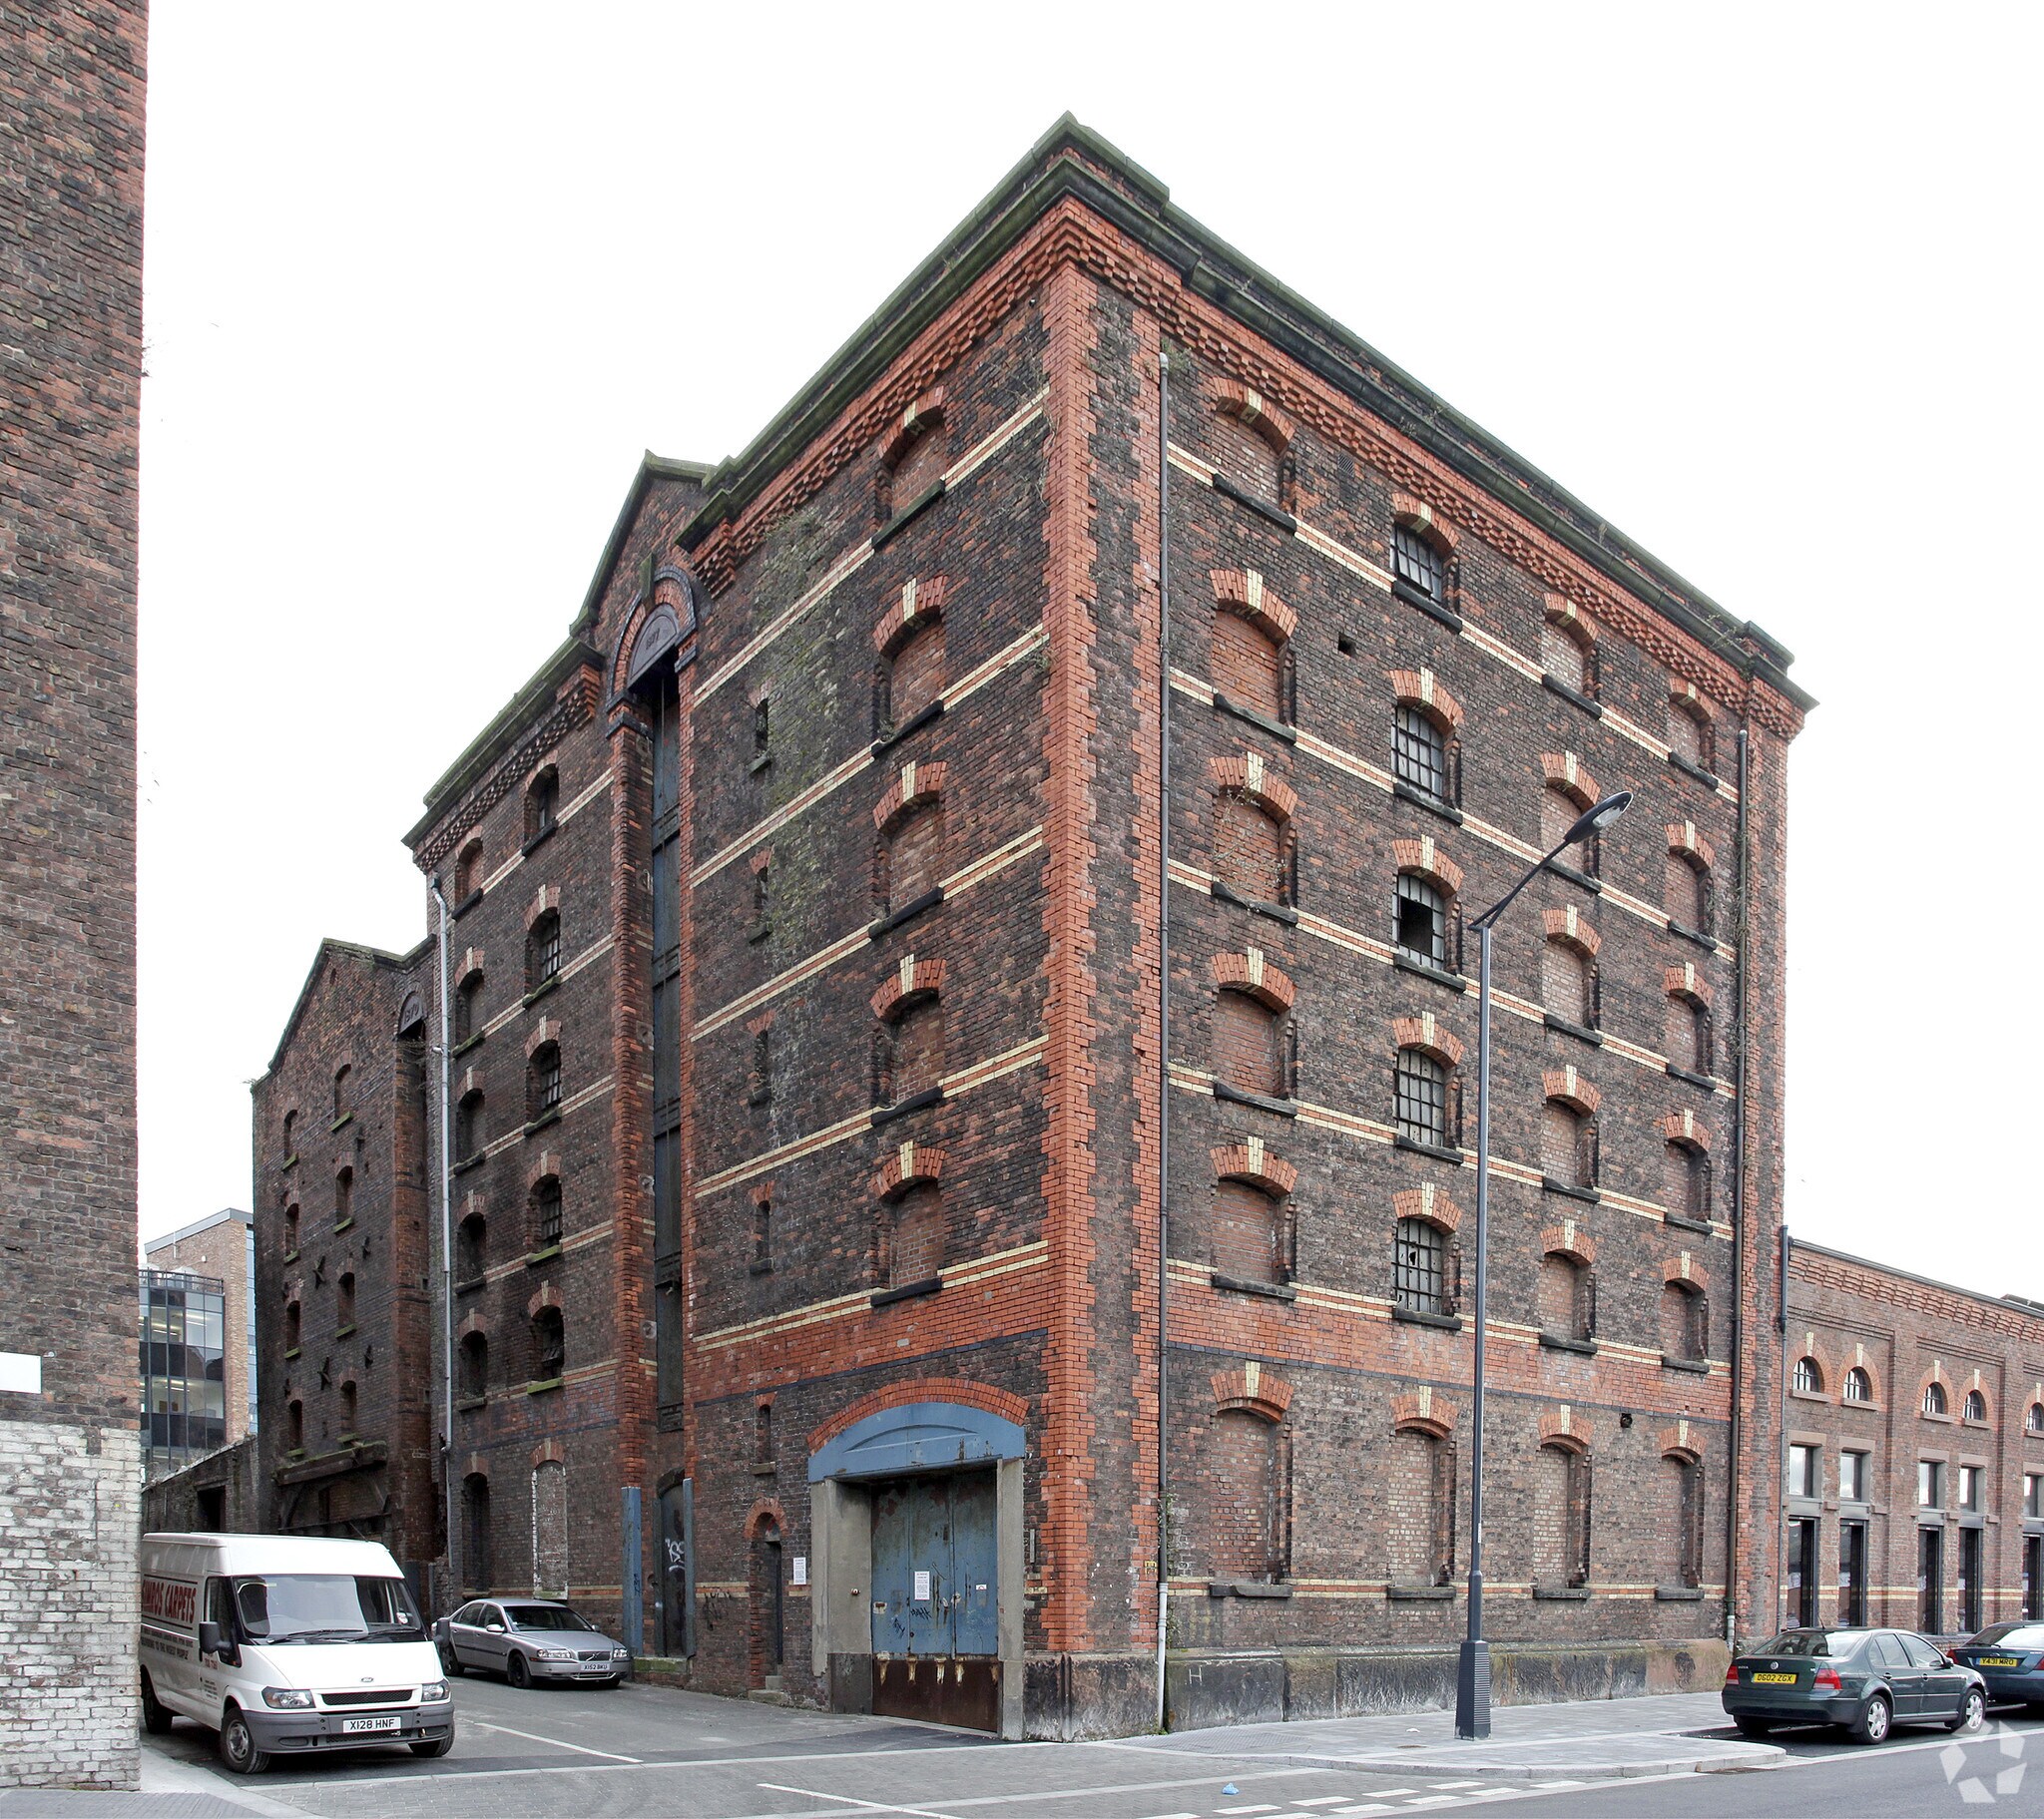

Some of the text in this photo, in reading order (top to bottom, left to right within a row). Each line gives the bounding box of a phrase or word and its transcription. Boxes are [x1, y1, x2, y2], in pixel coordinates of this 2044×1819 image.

[165, 1585, 197, 1623] CARPETS
[350, 1718, 394, 1730] X128 HNF
